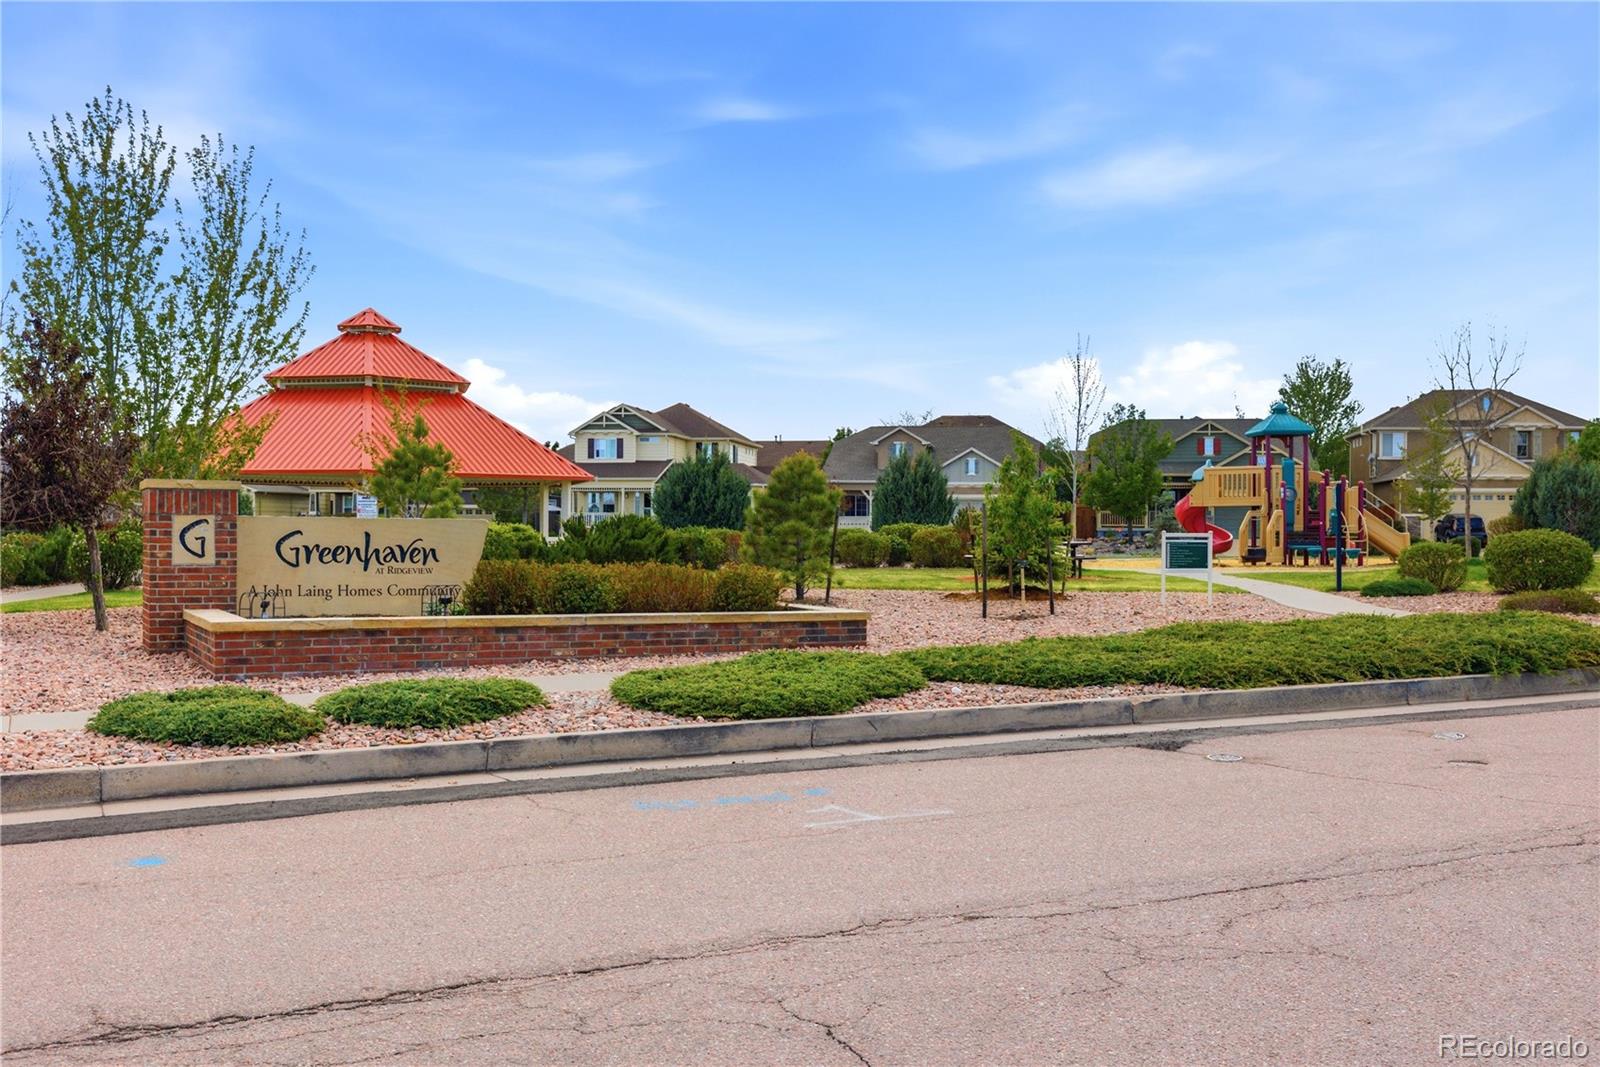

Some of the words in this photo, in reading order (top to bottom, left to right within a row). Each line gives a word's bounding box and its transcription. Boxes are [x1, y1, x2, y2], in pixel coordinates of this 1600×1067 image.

[179, 518, 209, 558] G
[275, 529, 440, 572] Greenhaven
[249, 584, 258, 597] A
[262, 584, 293, 600] John
[297, 584, 333, 601] Laing
[337, 584, 383, 597] Homes
[387, 583, 461, 600] Community
